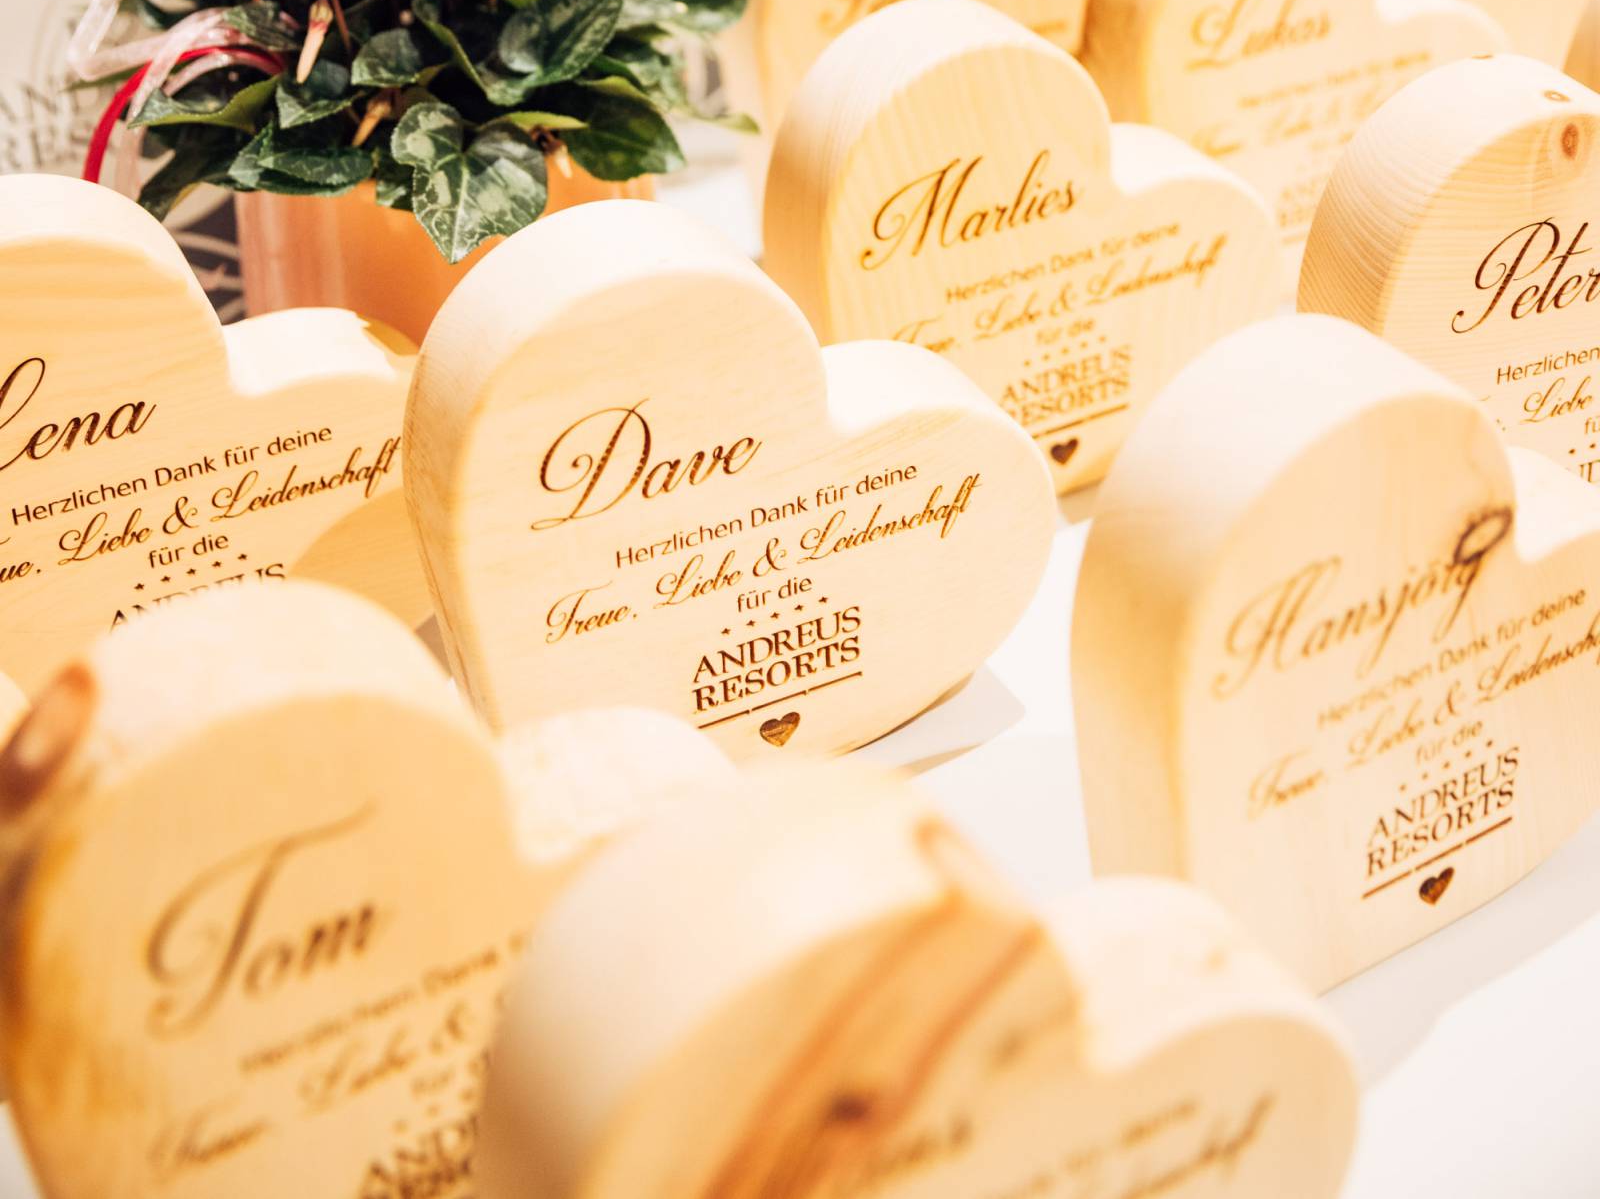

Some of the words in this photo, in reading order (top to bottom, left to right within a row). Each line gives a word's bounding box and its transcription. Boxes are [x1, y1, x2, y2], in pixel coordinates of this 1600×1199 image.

[860, 149, 1079, 270] Marlies
[1518, 376, 1594, 424] Liebe
[11, 476, 148, 525] Herzlichen
[154, 456, 217, 488] Dank
[224, 445, 260, 468] für
[267, 425, 333, 456] deine
[58, 508, 152, 566] Liebe
[162, 496, 199, 534] &
[210, 436, 402, 523] Leidenschaft
[530, 397, 763, 531] Dave
[148, 543, 185, 569] für
[192, 532, 230, 557] die
[614, 516, 744, 569] Herzlichen
[751, 494, 809, 531] Dank
[815, 483, 850, 507] für
[855, 462, 918, 498] deine
[653, 554, 743, 609] Liebe
[753, 537, 788, 576] &
[799, 473, 984, 564] Leidenschaft
[736, 588, 774, 612] für
[778, 576, 813, 604] die
[1531, 588, 1586, 628] deine
[692, 605, 863, 685] ANDREUS
[693, 636, 862, 713] RESORTS
[1452, 719, 1484, 749] die
[1365, 780, 1515, 878] RESORTS
[1368, 746, 1520, 847] ANDREUS
[145, 799, 380, 1041] Tom
